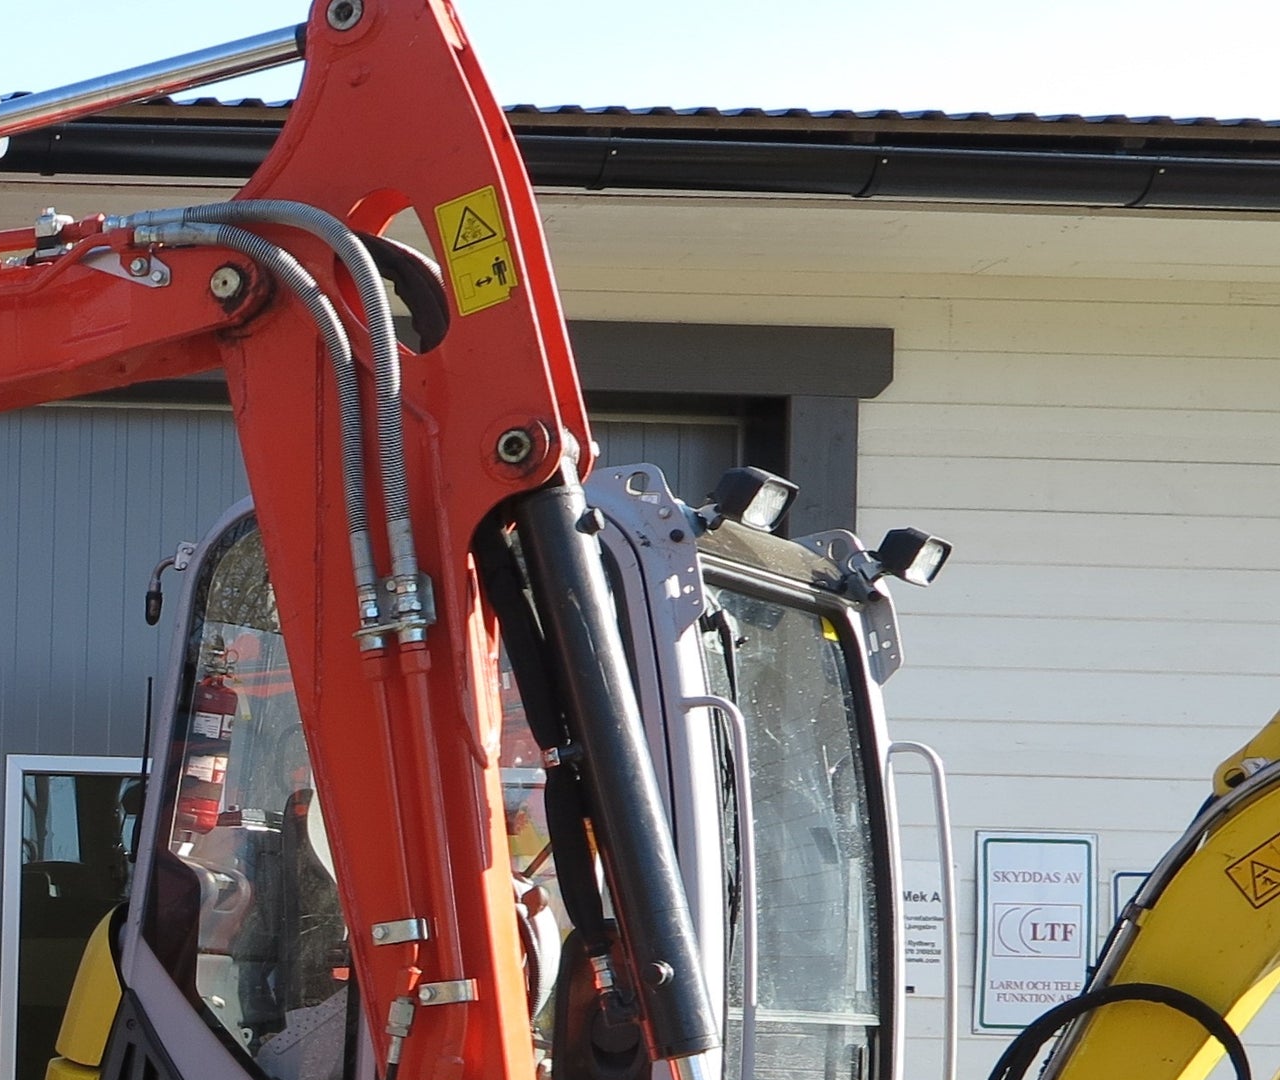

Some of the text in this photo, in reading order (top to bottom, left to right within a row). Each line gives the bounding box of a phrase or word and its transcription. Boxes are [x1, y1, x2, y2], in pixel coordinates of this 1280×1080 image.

[993, 871, 1082, 883] SKYDDAS AV
[1030, 922, 1077, 942] LTF
[990, 980, 1081, 992] LARM OCH TELE
[996, 993, 1056, 1004] FUNKTION
